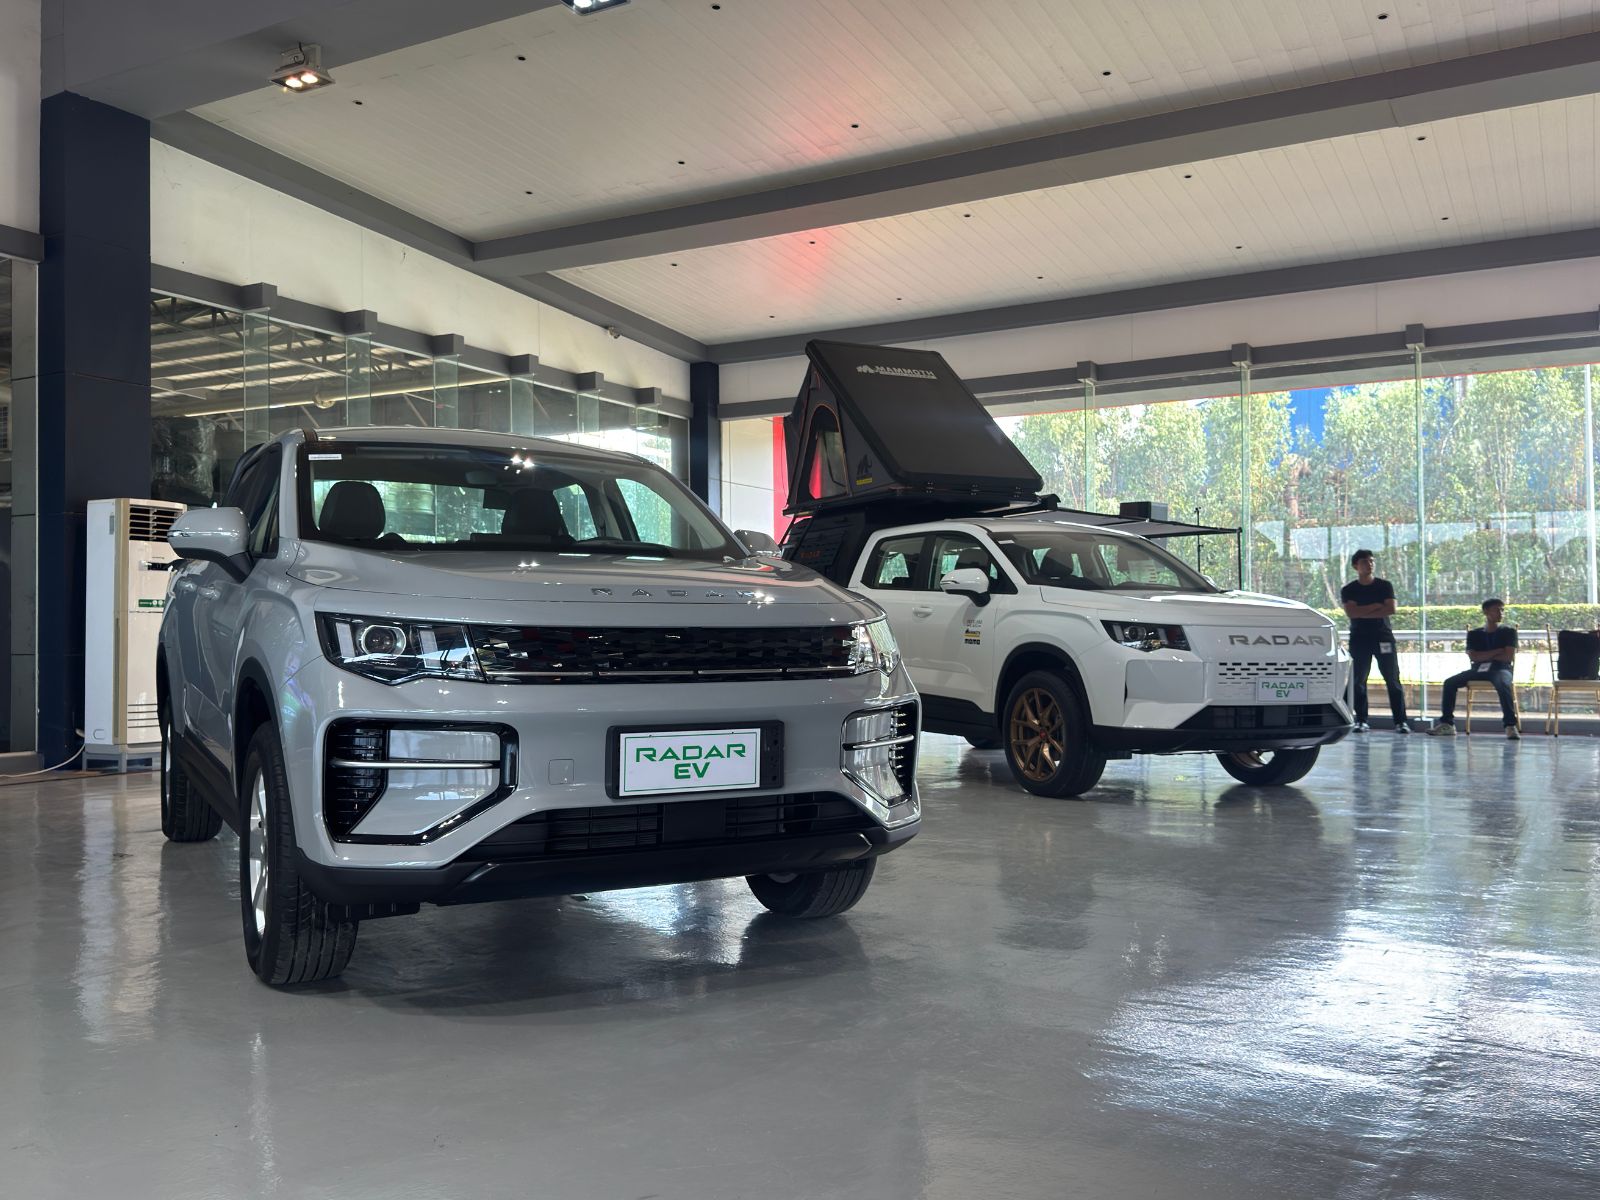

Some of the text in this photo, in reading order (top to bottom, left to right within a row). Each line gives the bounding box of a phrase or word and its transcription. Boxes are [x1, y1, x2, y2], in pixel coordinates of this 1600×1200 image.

[1228, 635, 1326, 646] RADAR
[1276, 690, 1290, 698] EV
[635, 743, 746, 763] RADAR
[674, 762, 710, 780] EV
